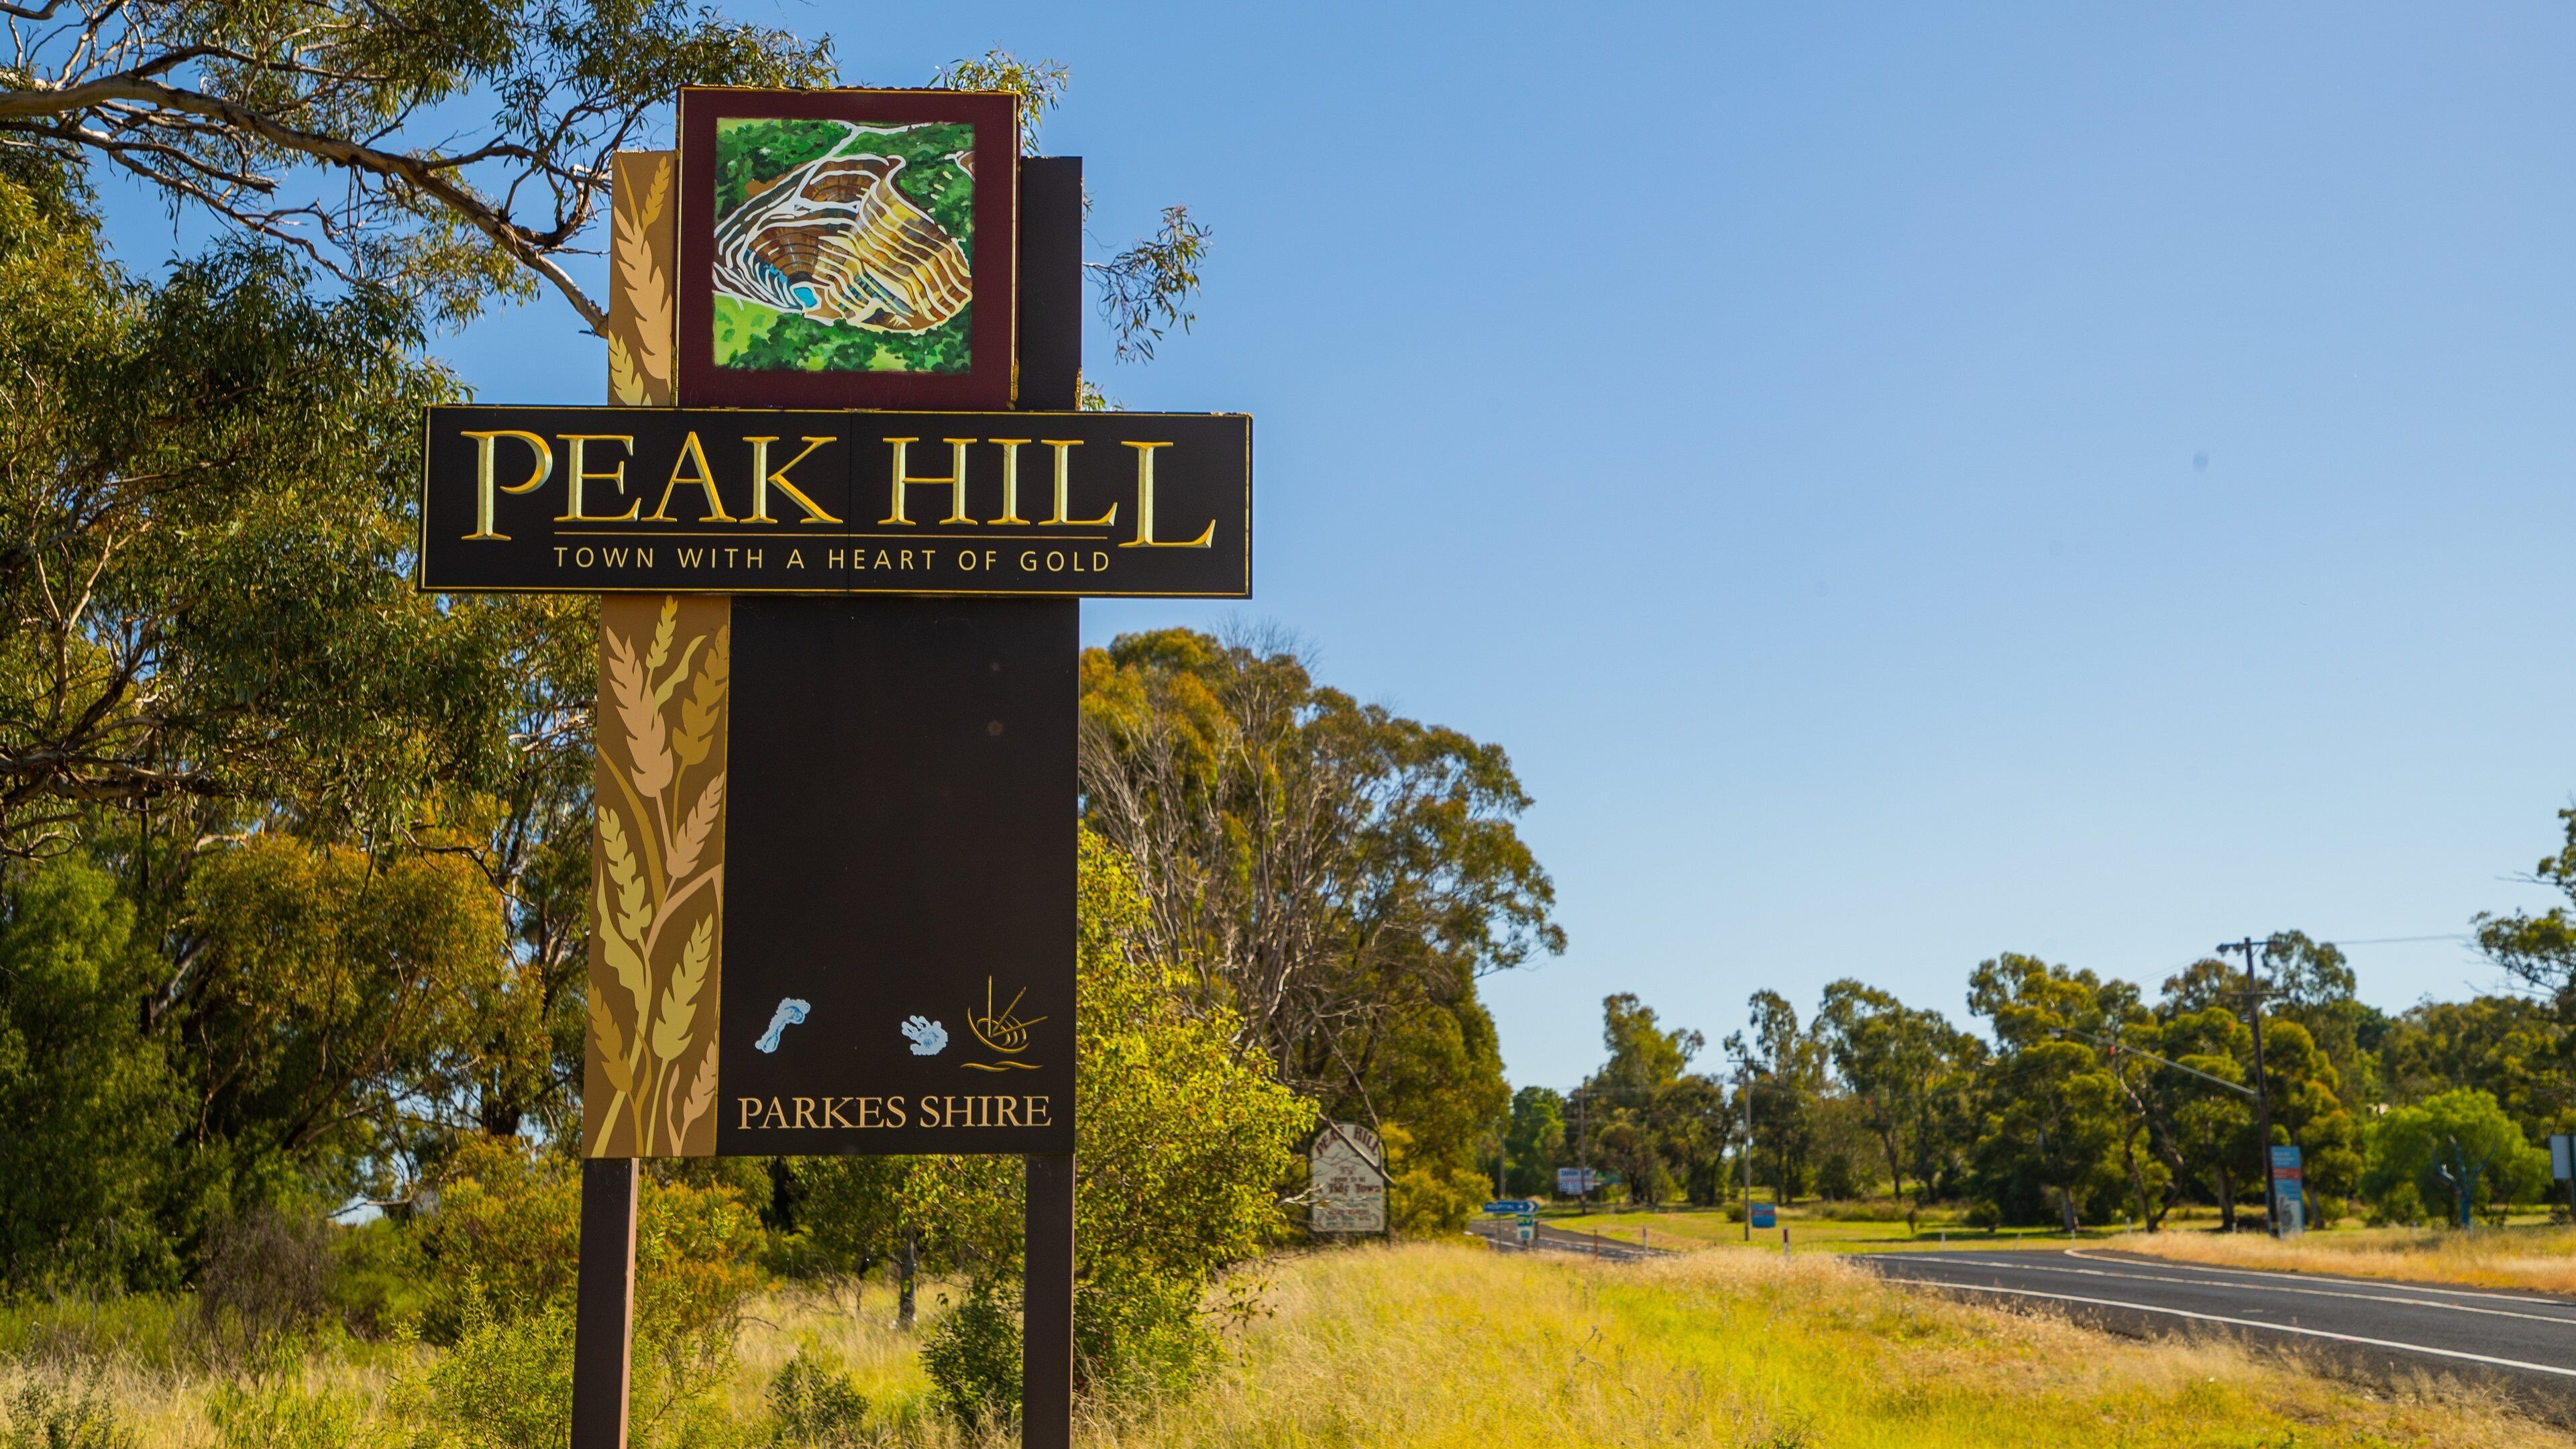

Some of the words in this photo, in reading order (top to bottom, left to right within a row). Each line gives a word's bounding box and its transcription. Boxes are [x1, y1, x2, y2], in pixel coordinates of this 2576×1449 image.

[460, 430, 843, 541] PEAK
[877, 437, 1216, 549] HILL
[553, 546, 654, 568] TOWN
[677, 547, 763, 569] WITH
[786, 548, 805, 569] A
[828, 548, 936, 570] HEART
[958, 550, 998, 570] OF
[1019, 550, 1110, 572] GOLD
[737, 1095, 906, 1130] PARKES
[920, 1095, 1052, 1128] SHIRE
[1353, 1125, 1379, 1156] HILL
